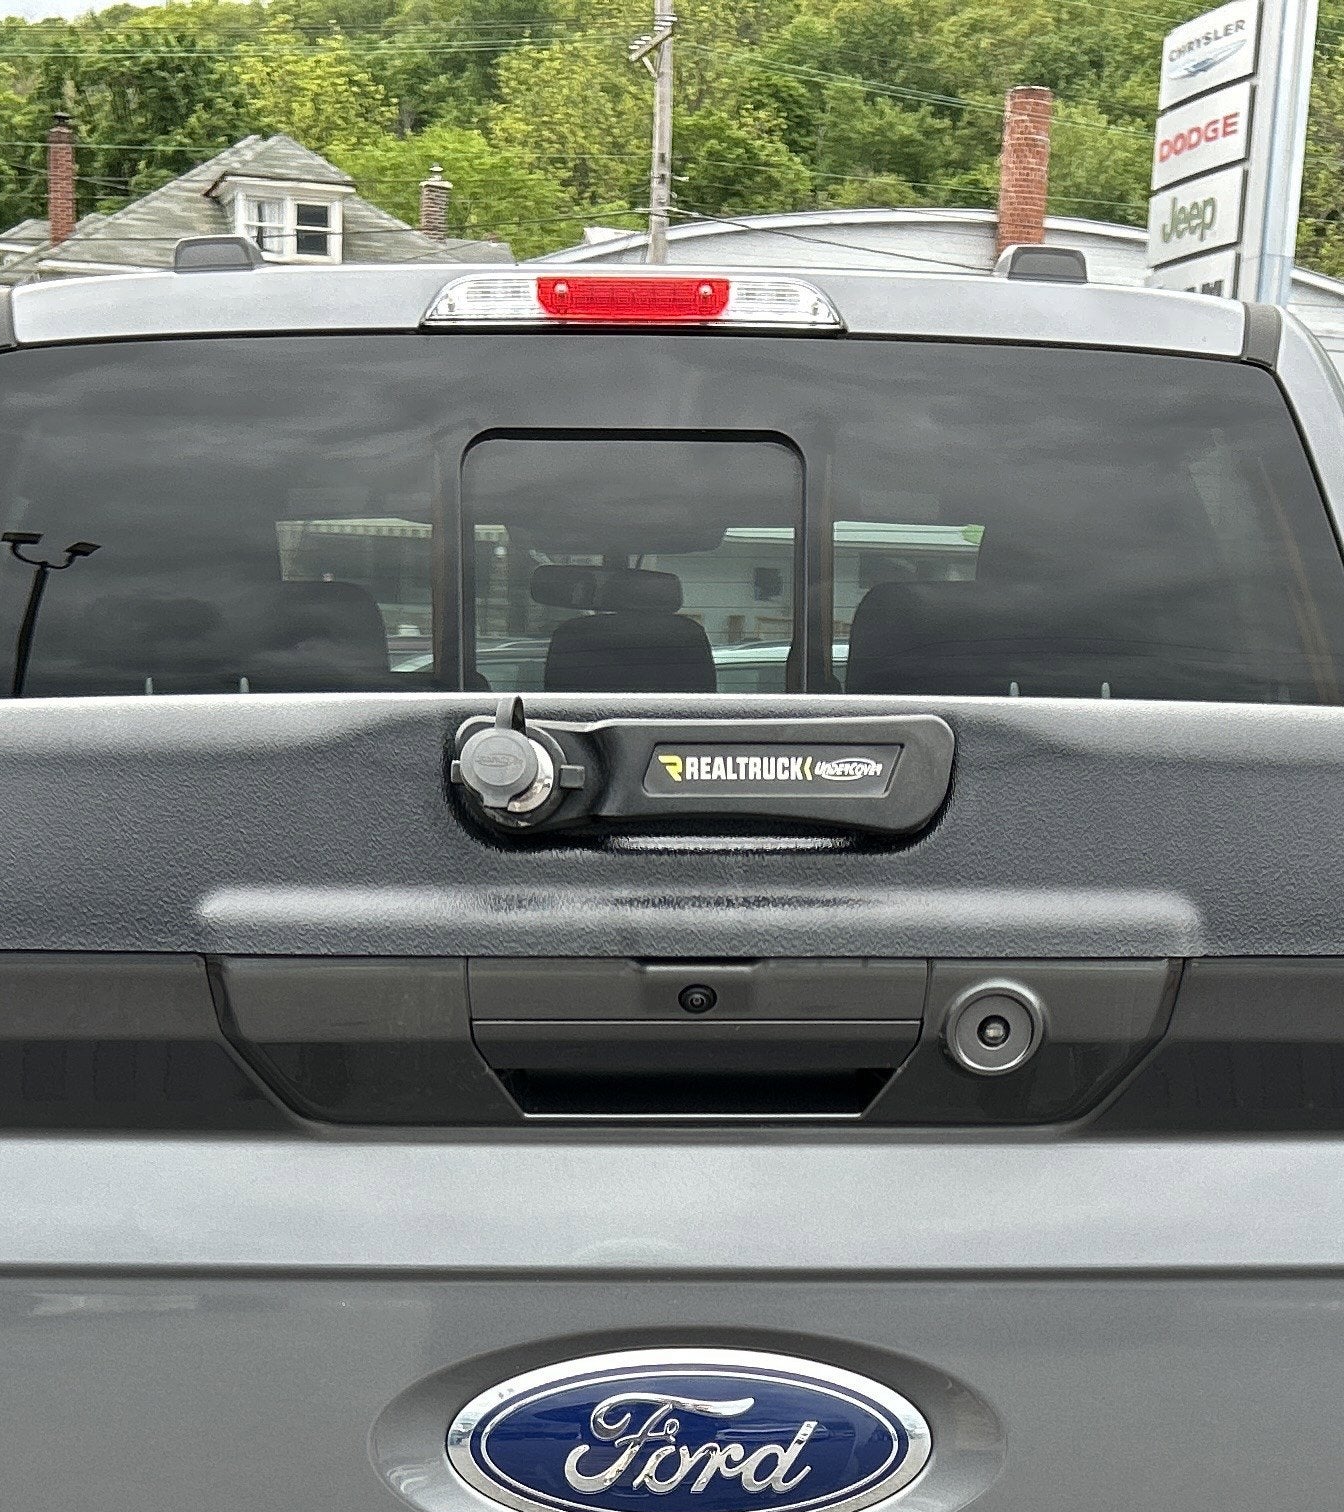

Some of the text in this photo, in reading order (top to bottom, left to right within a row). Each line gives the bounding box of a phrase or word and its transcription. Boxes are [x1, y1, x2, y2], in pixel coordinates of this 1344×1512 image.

[1168, 19, 1246, 63] CHRYSLER
[1159, 112, 1239, 163] DODGE
[1161, 196, 1217, 244] Jeep
[685, 756, 804, 780] REALTRUCK
[564, 1392, 819, 1495] Ford
